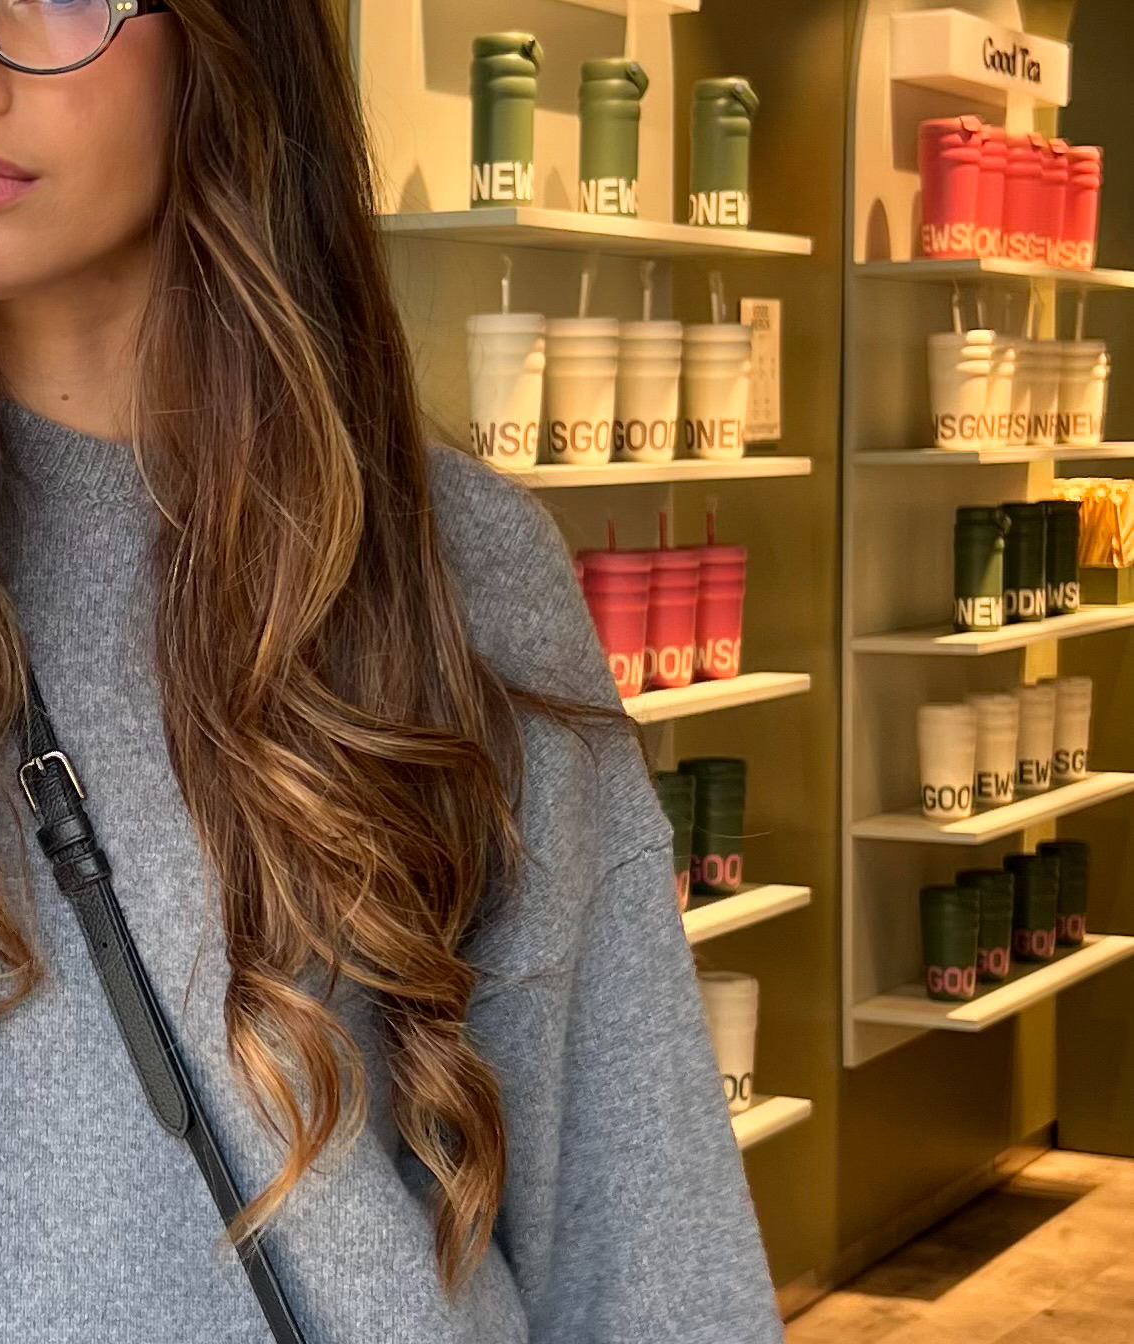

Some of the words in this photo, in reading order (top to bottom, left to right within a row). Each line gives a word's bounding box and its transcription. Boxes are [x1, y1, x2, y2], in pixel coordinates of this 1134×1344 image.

[982, 36, 1016, 77] Good
[1019, 47, 1041, 83] Tea
[580, 177, 639, 215] NEW
[547, 419, 610, 453] SGO
